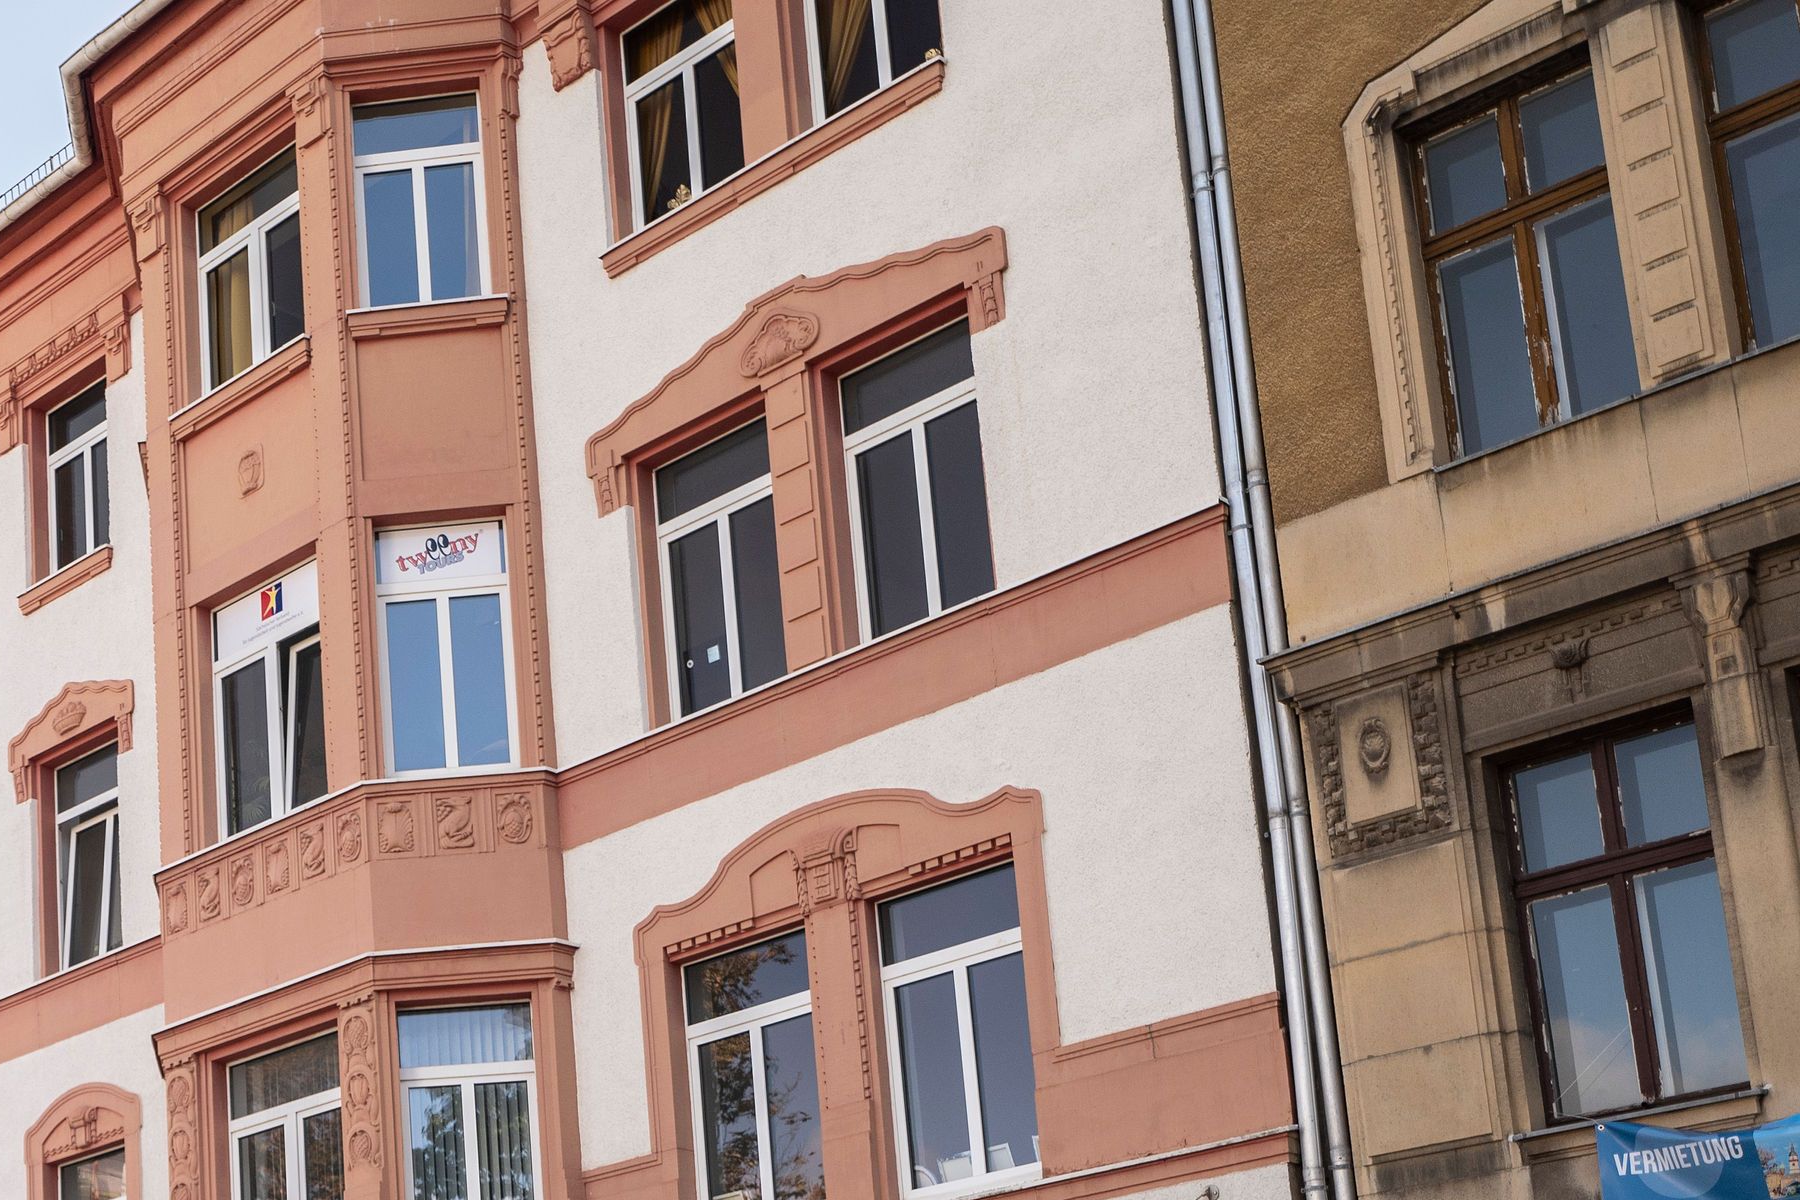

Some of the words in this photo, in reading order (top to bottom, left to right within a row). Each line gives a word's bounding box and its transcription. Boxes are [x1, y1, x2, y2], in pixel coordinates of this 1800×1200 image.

[395, 533, 479, 572] tweeny
[418, 551, 465, 575] TOURS
[1613, 1136, 1743, 1176] VERMIETUNG
